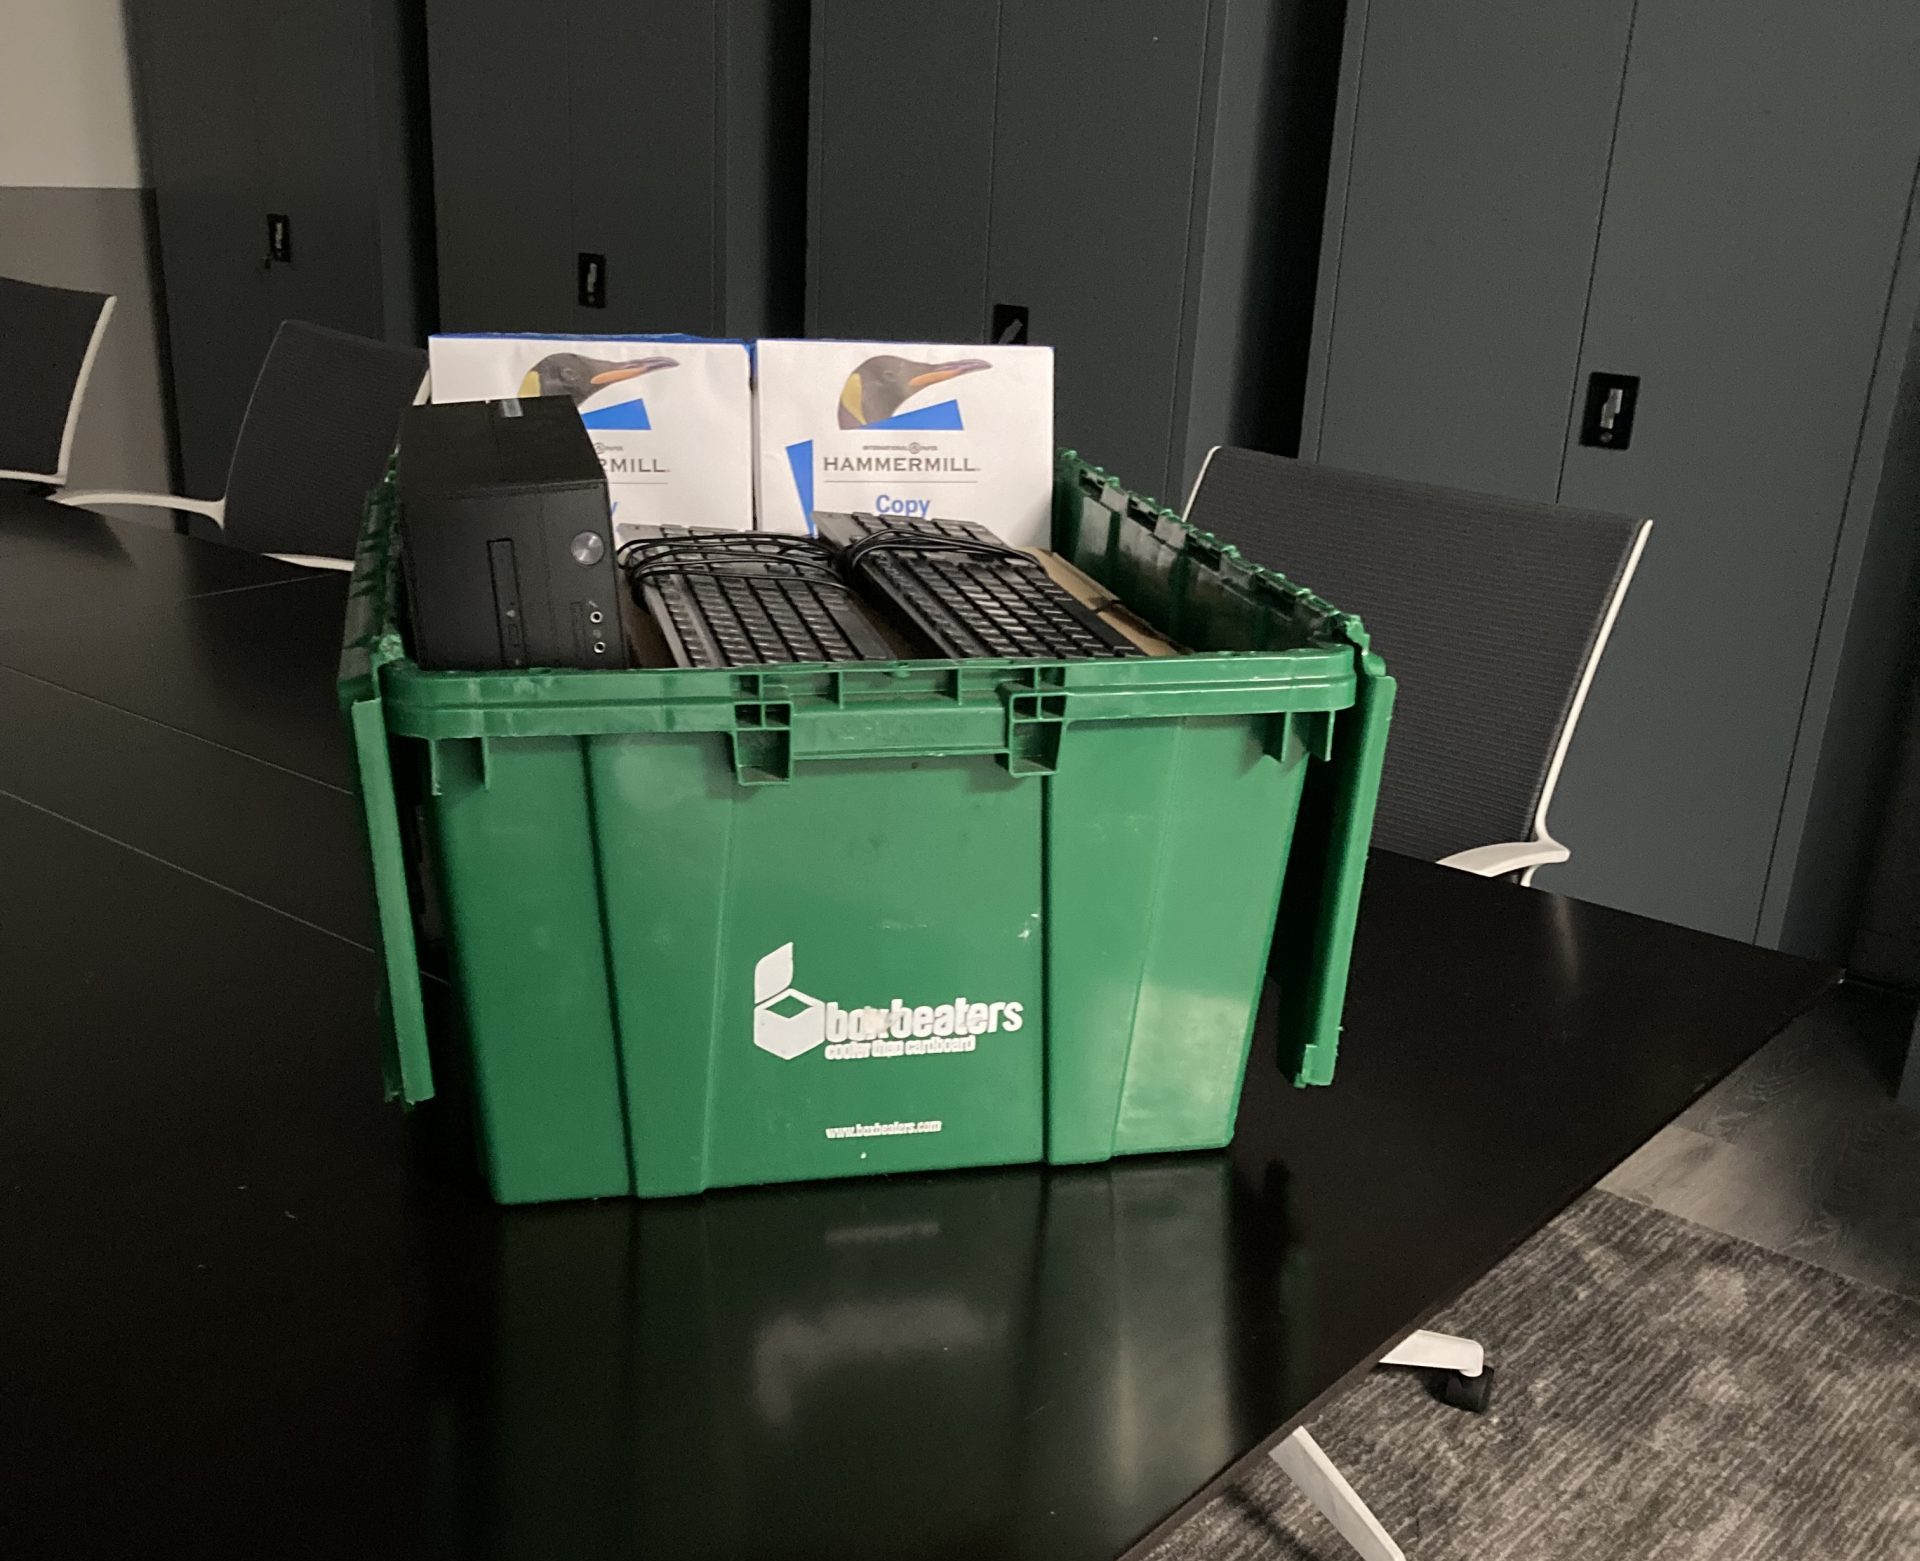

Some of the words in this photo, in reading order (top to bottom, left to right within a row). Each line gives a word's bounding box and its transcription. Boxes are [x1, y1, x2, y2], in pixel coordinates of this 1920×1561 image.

[823, 456, 978, 472] HAMMERMILL
[875, 494, 931, 519] Copy
[905, 1034, 976, 1055] cardboard
[825, 1120, 942, 1139] www.boxbeaters.com
